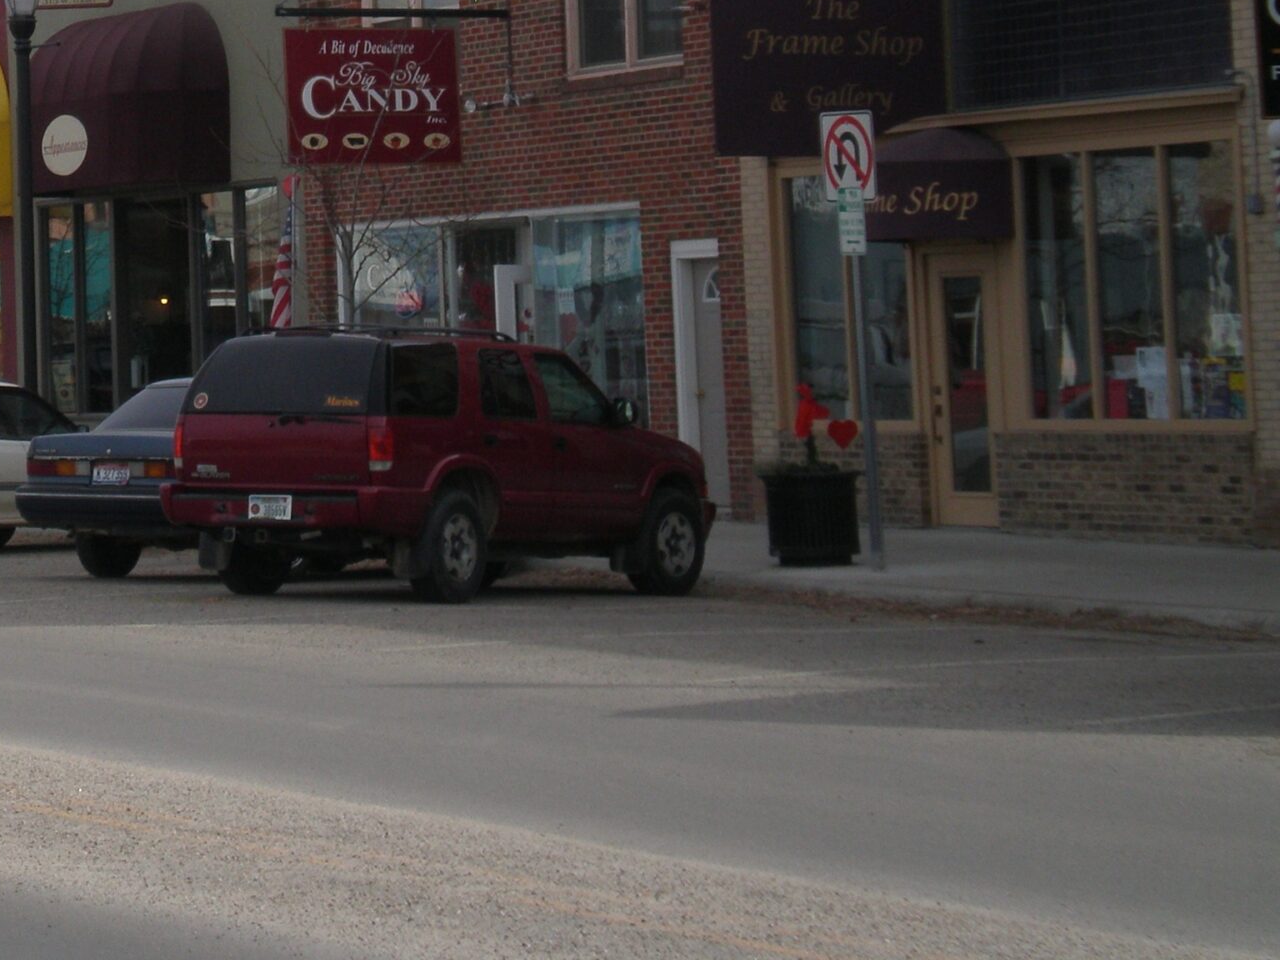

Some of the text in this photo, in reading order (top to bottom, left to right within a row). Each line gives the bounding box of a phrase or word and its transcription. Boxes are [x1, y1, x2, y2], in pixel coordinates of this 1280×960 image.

[319, 40, 415, 57] A Bit of Decadence
[742, 26, 924, 65] Frame Shop
[335, 60, 431, 91] Big Sky
[770, 84, 894, 115] & Gallery
[426, 115, 448, 125] Inc.
[903, 182, 979, 221] Shop
